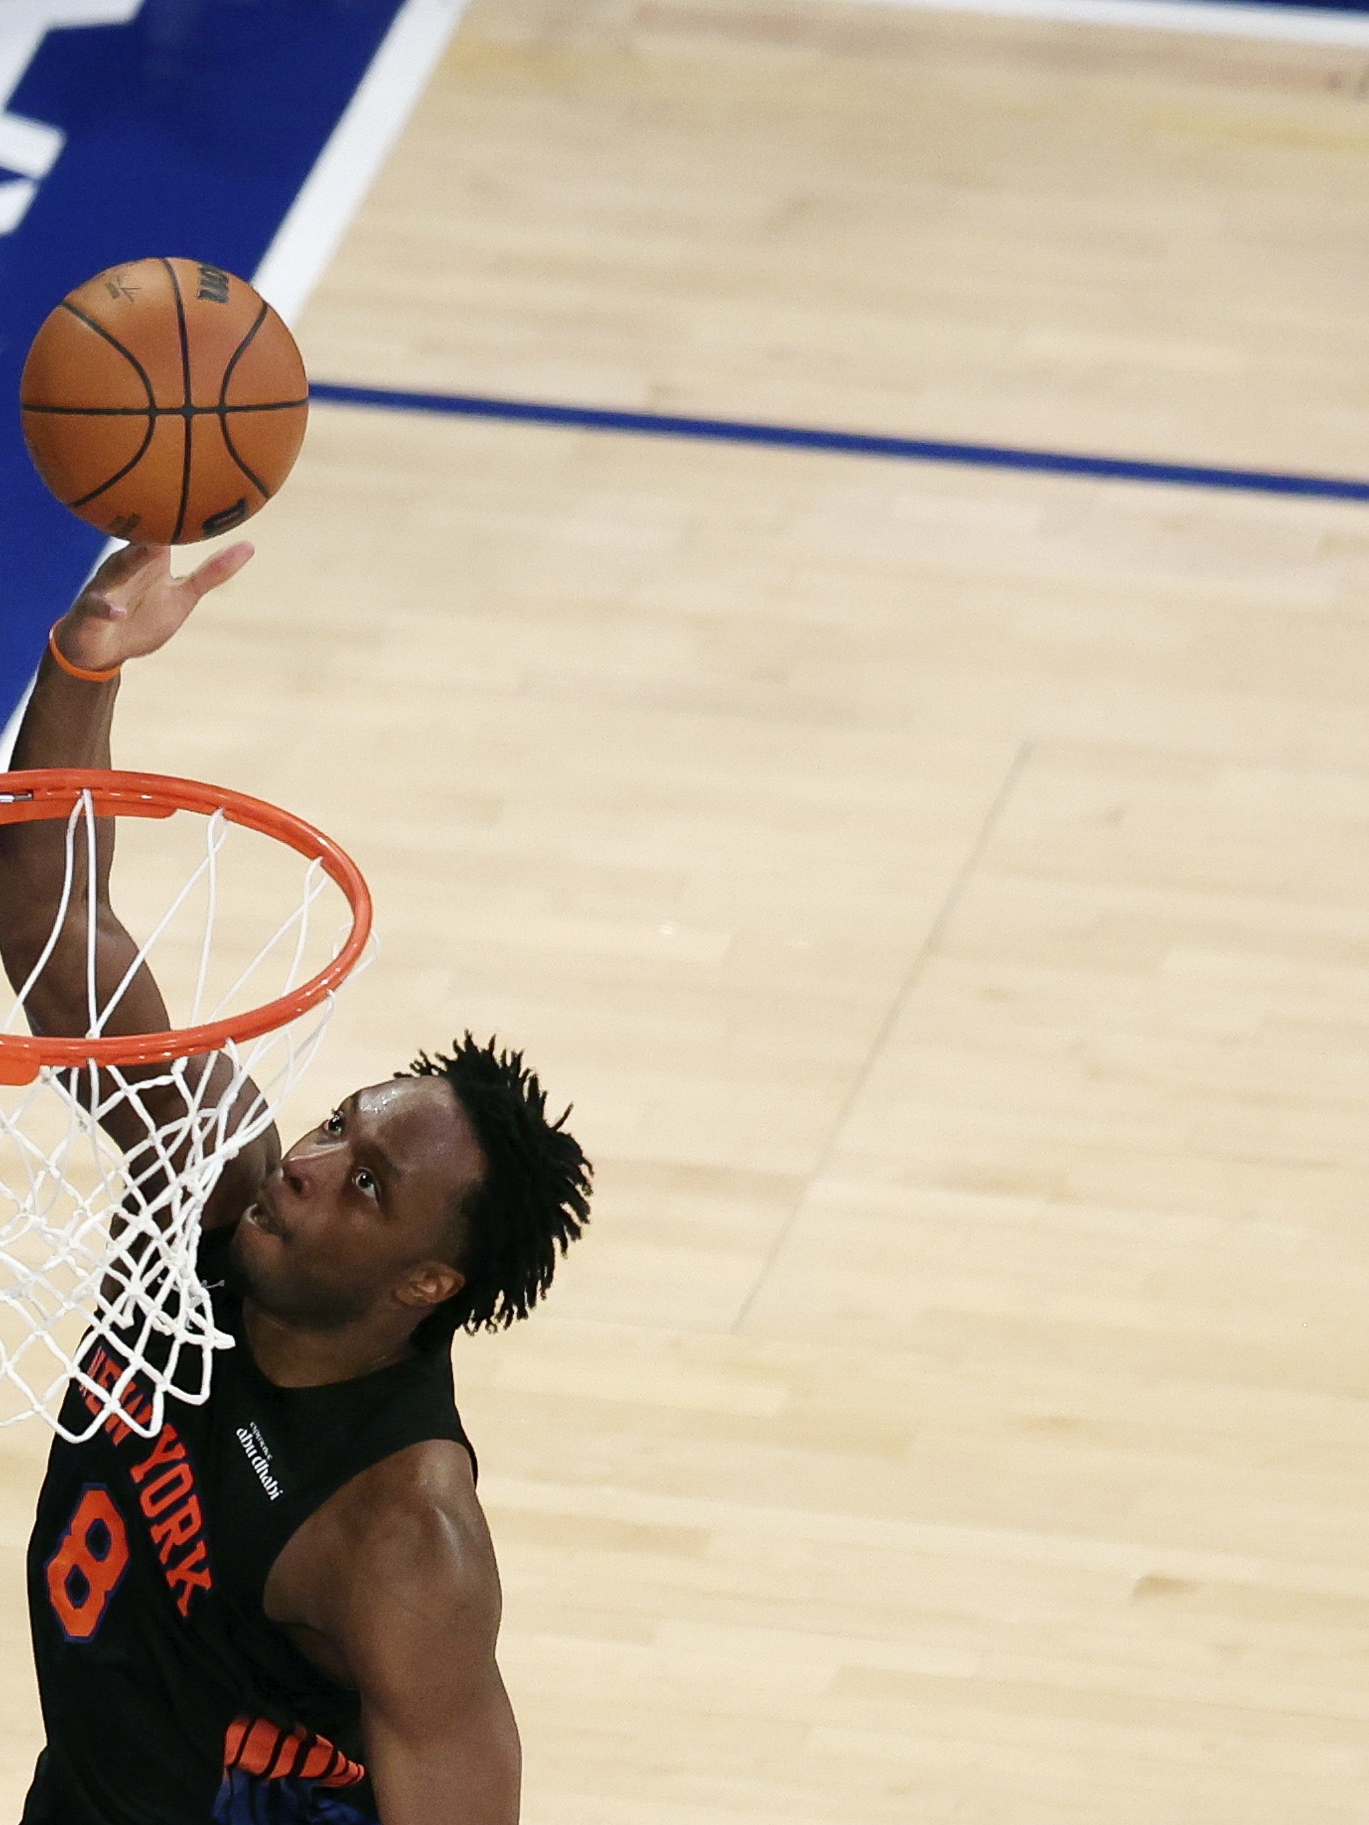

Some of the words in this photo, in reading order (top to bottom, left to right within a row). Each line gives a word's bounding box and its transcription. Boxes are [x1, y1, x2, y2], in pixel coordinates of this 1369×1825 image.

[129, 1423, 214, 1617] YORK
[237, 1428, 258, 1459] abu
[252, 1456, 283, 1500] dhabi
[43, 1483, 130, 1643] 8
